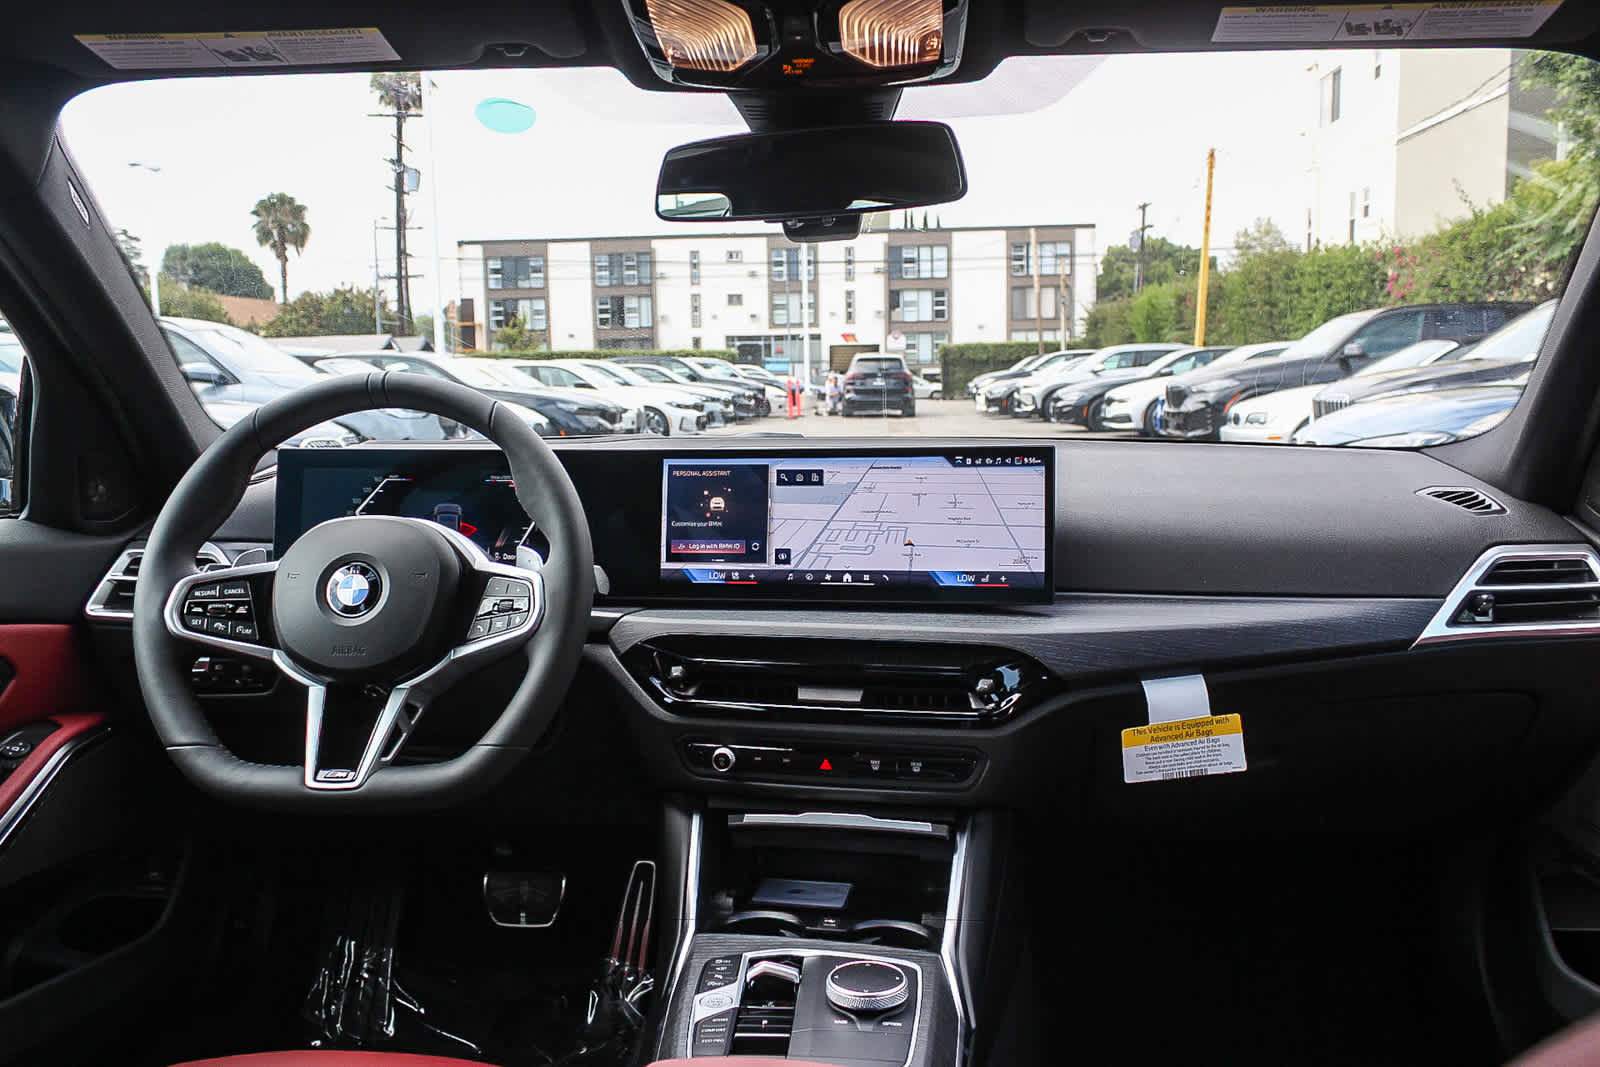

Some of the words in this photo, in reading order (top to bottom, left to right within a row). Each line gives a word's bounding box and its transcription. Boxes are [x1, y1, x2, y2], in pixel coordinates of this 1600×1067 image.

[689, 543, 699, 551] Log
[709, 572, 726, 580] LOW
[957, 574, 976, 582] LOW
[1131, 728, 1147, 736] This
[1148, 724, 1173, 734] Vehicle
[1174, 722, 1180, 730] is
[1182, 718, 1214, 730] Equipped
[1215, 716, 1230, 725] with
[1150, 732, 1184, 743] Advanced
[1185, 730, 1195, 738] Air
[1196, 729, 1214, 739] Bags
[1171, 739, 1197, 749] Advanced
[1207, 737, 1220, 745] Bags
